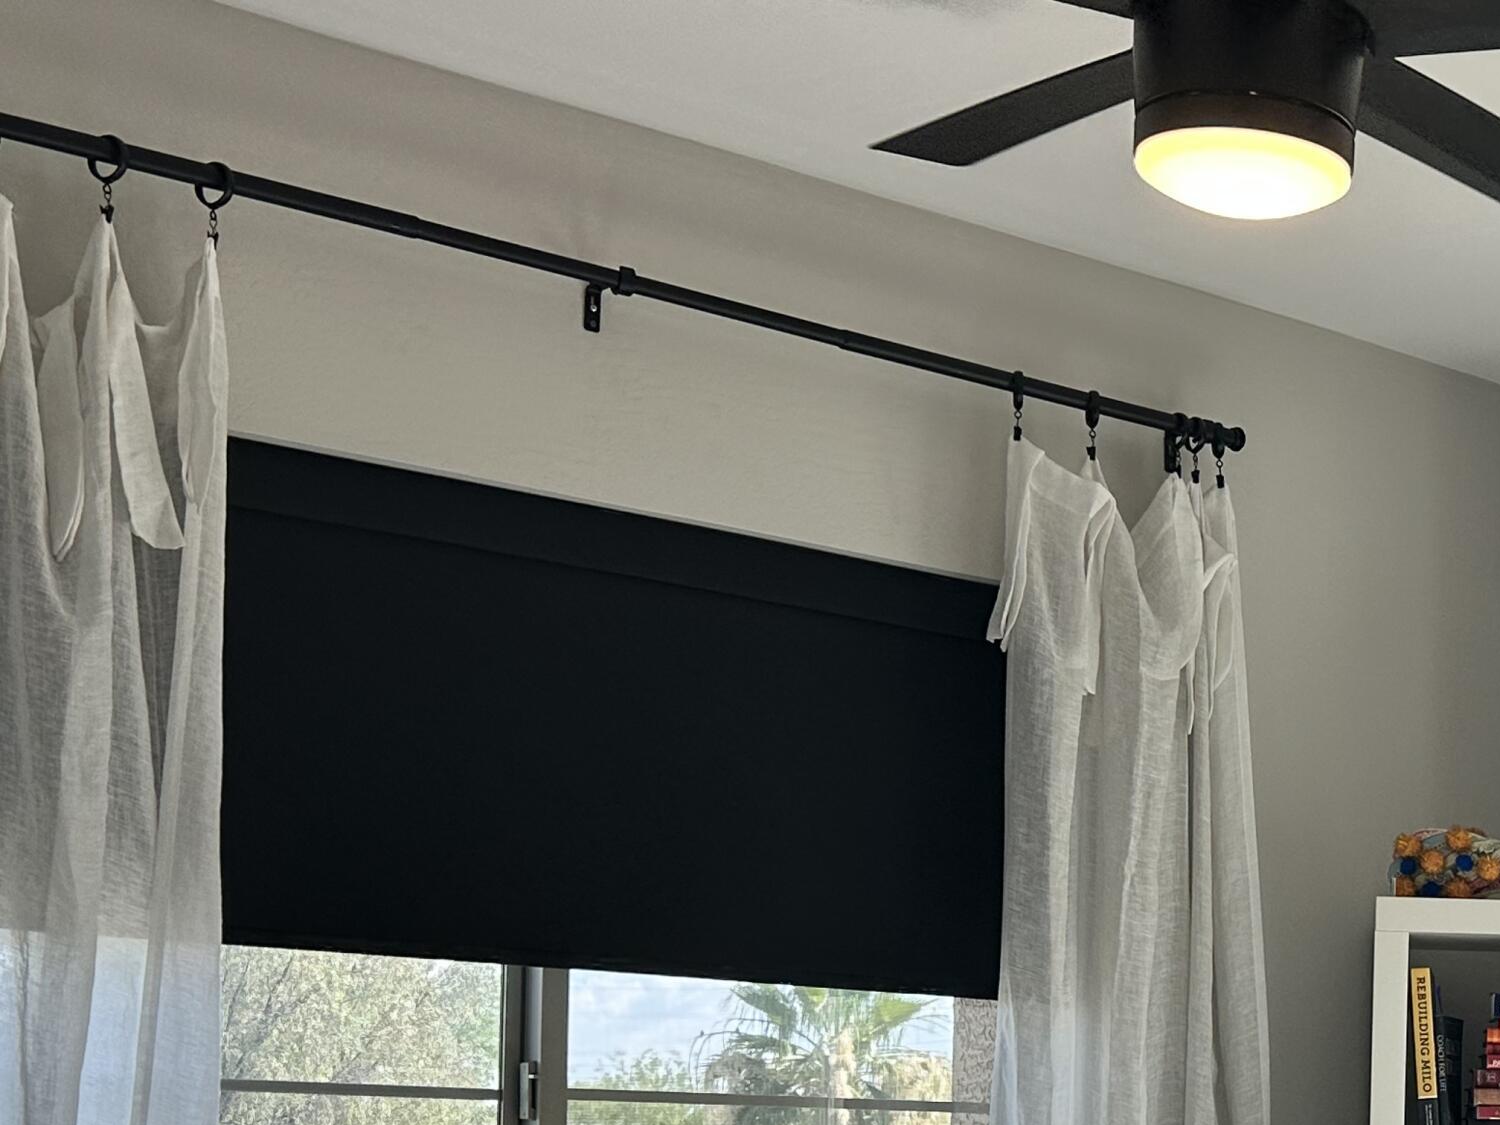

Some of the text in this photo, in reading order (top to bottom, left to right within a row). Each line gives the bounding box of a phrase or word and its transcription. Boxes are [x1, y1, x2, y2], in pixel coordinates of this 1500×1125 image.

[1416, 976, 1430, 1056] REBUILDING
[1421, 1061, 1432, 1093] MILO
[1439, 1080, 1447, 1092] LIFE
